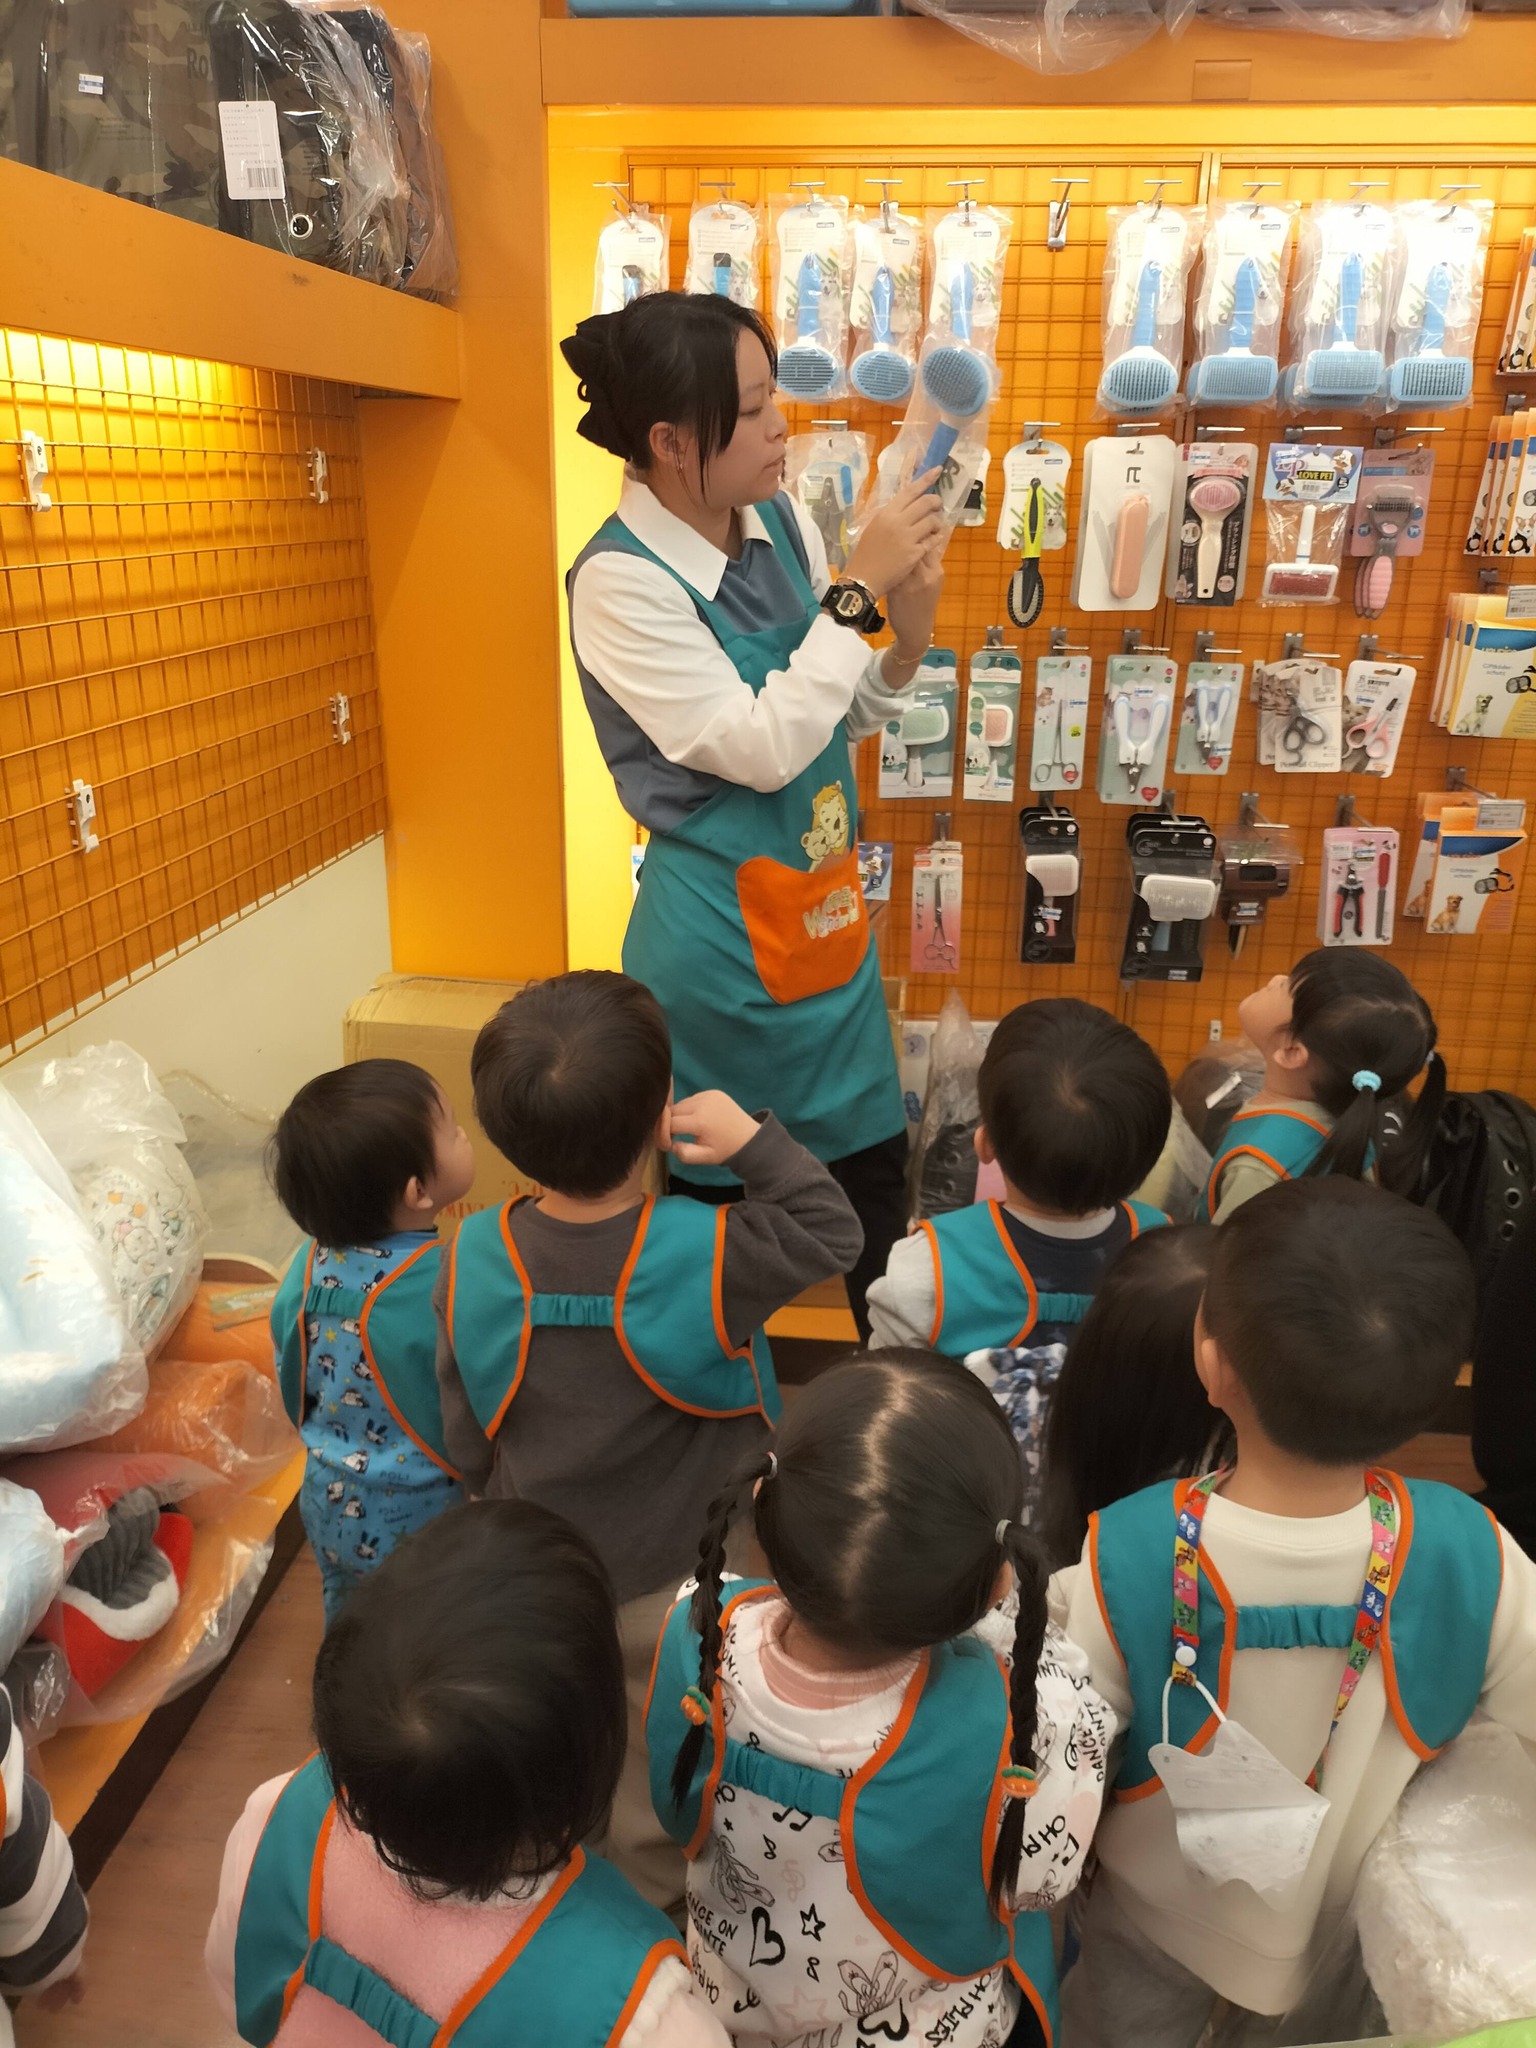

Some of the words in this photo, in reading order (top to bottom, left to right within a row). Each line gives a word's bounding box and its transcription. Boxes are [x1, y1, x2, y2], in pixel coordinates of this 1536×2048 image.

[1299, 471, 1319, 480] LOVE
[1319, 472, 1333, 480] PET
[686, 1890, 715, 1926] ANCE
[718, 1919, 739, 1941] ON
[967, 1972, 992, 2002] OH
